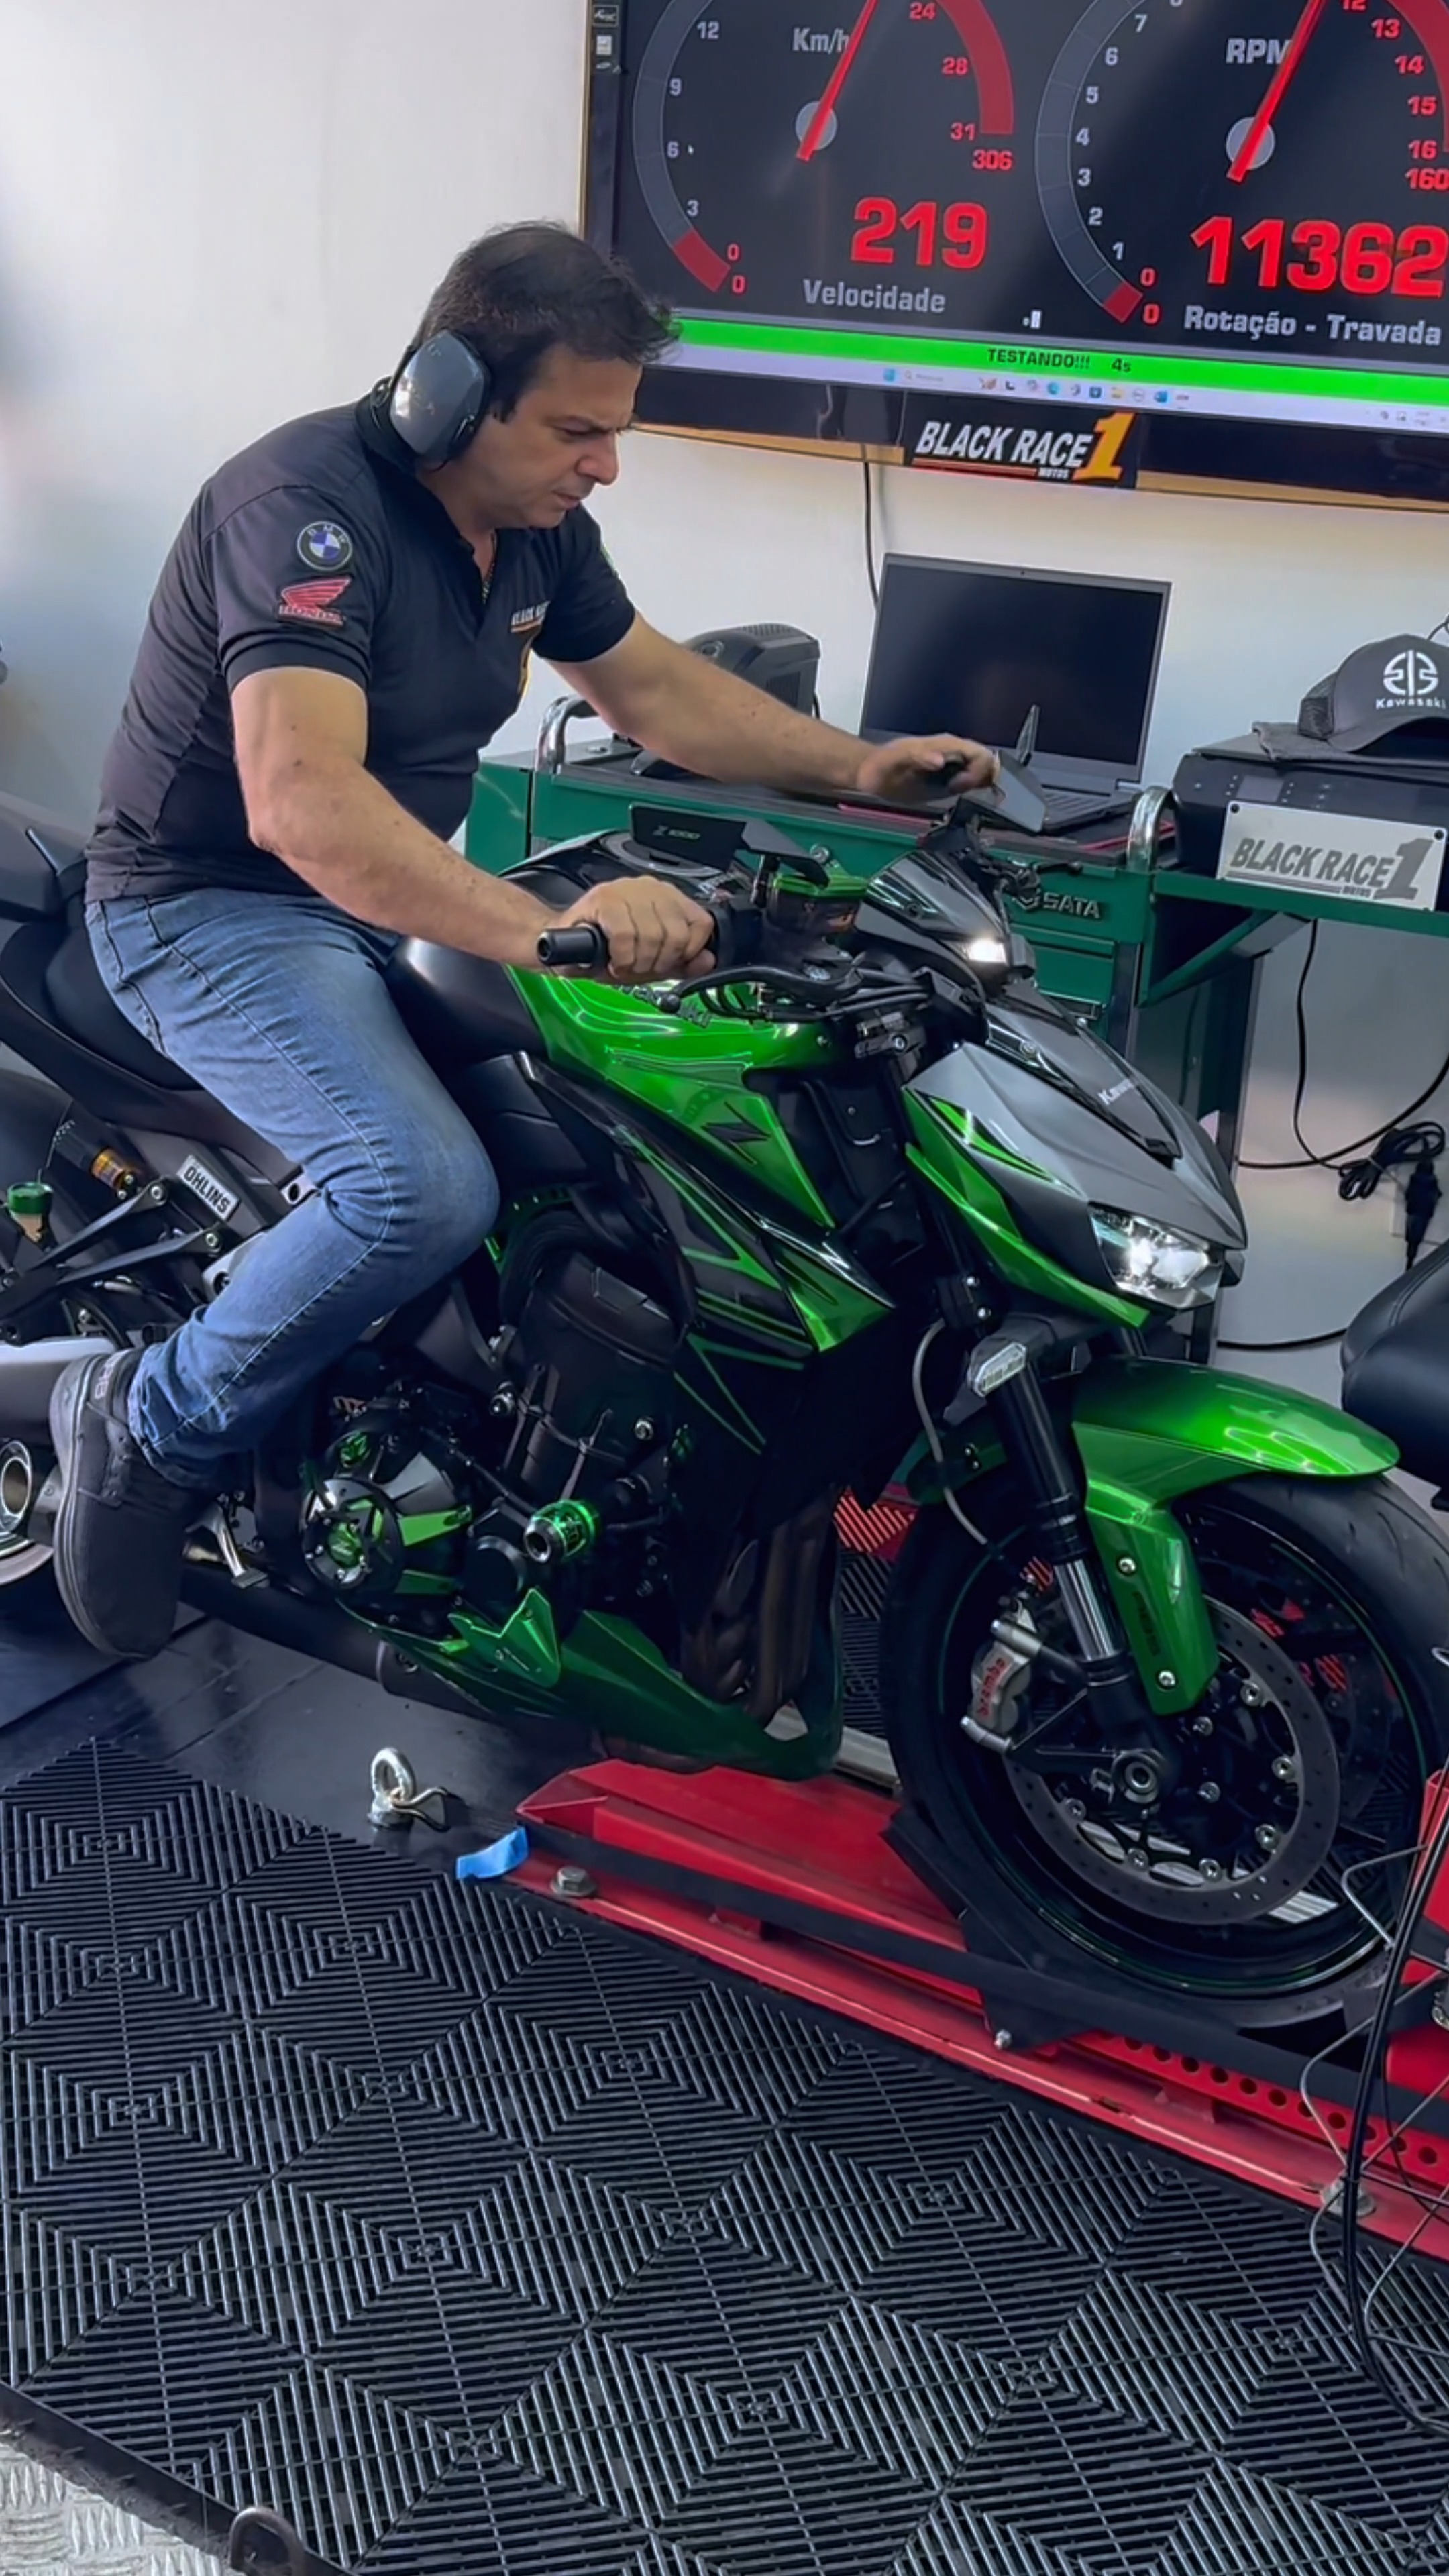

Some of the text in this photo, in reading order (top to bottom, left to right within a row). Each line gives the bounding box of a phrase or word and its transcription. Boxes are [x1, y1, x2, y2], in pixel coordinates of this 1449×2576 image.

[909, 2, 936, 20] 24
[697, 21, 720, 39] 12
[1134, 14, 1148, 32] 7
[1371, 18, 1401, 38] 13
[792, 28, 850, 54] Km/h
[941, 57, 968, 75] 28
[1105, 47, 1118, 66] 6
[1395, 55, 1424, 74] 14
[669, 78, 682, 96] 9
[1085, 86, 1099, 103] 5
[1407, 96, 1436, 115] 15
[951, 123, 975, 140] 31
[1075, 127, 1090, 146] 4
[667, 141, 679, 158] 6
[1408, 140, 1437, 158] 16
[973, 150, 1012, 170] 306
[1077, 168, 1091, 186] 3
[687, 200, 698, 216] 3
[1089, 207, 1103, 225] 2
[850, 196, 988, 270] 219
[727, 244, 739, 261] 0
[1112, 242, 1124, 260] 1
[1190, 215, 1449, 298] 11362
[732, 276, 745, 294] 0
[1140, 267, 1155, 286] 0
[802, 278, 946, 313] Velocidade
[1143, 303, 1159, 324] 0
[1184, 304, 1297, 341] Rotação
[1326, 313, 1441, 346] Travada
[988, 348, 1132, 373] TESTANDO!!! 4s
[914, 421, 1014, 462] BLACK
[1011, 429, 1093, 468] RACE
[1375, 697, 1446, 710] Kawasaki
[1230, 837, 1323, 877] BLACK
[1315, 849, 1395, 888] RACE
[1043, 892, 1101, 920] SATA
